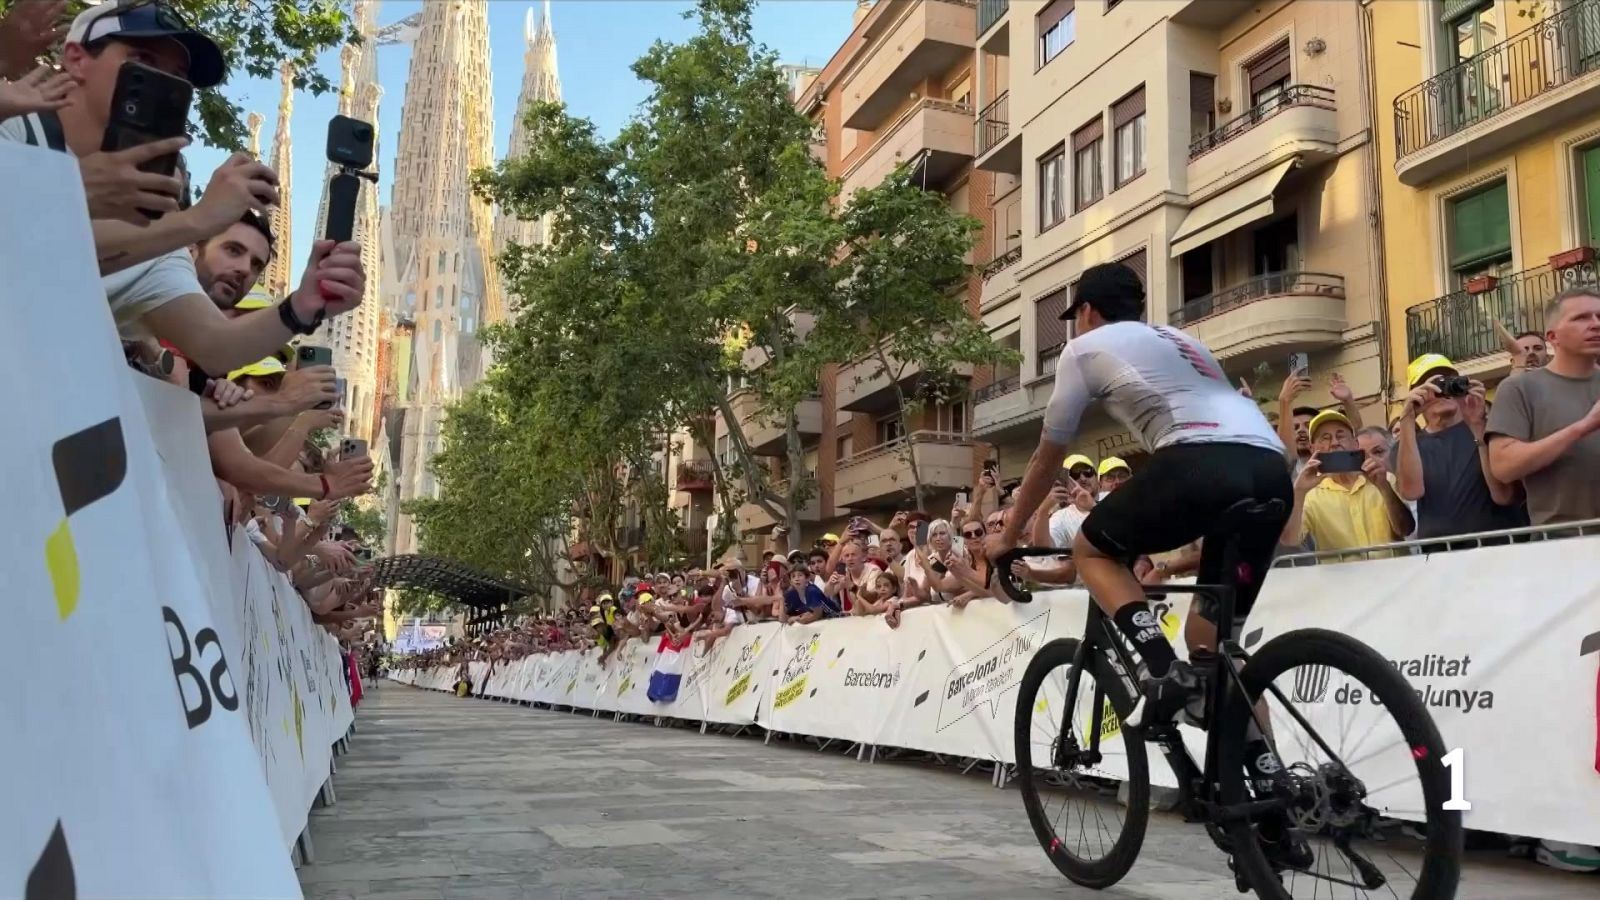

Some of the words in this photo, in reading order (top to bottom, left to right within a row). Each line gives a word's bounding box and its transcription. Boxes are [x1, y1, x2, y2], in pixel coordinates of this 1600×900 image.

[844, 667, 893, 689] Barcelona
[947, 655, 997, 700] Barcelona
[1334, 683, 1363, 705] de
